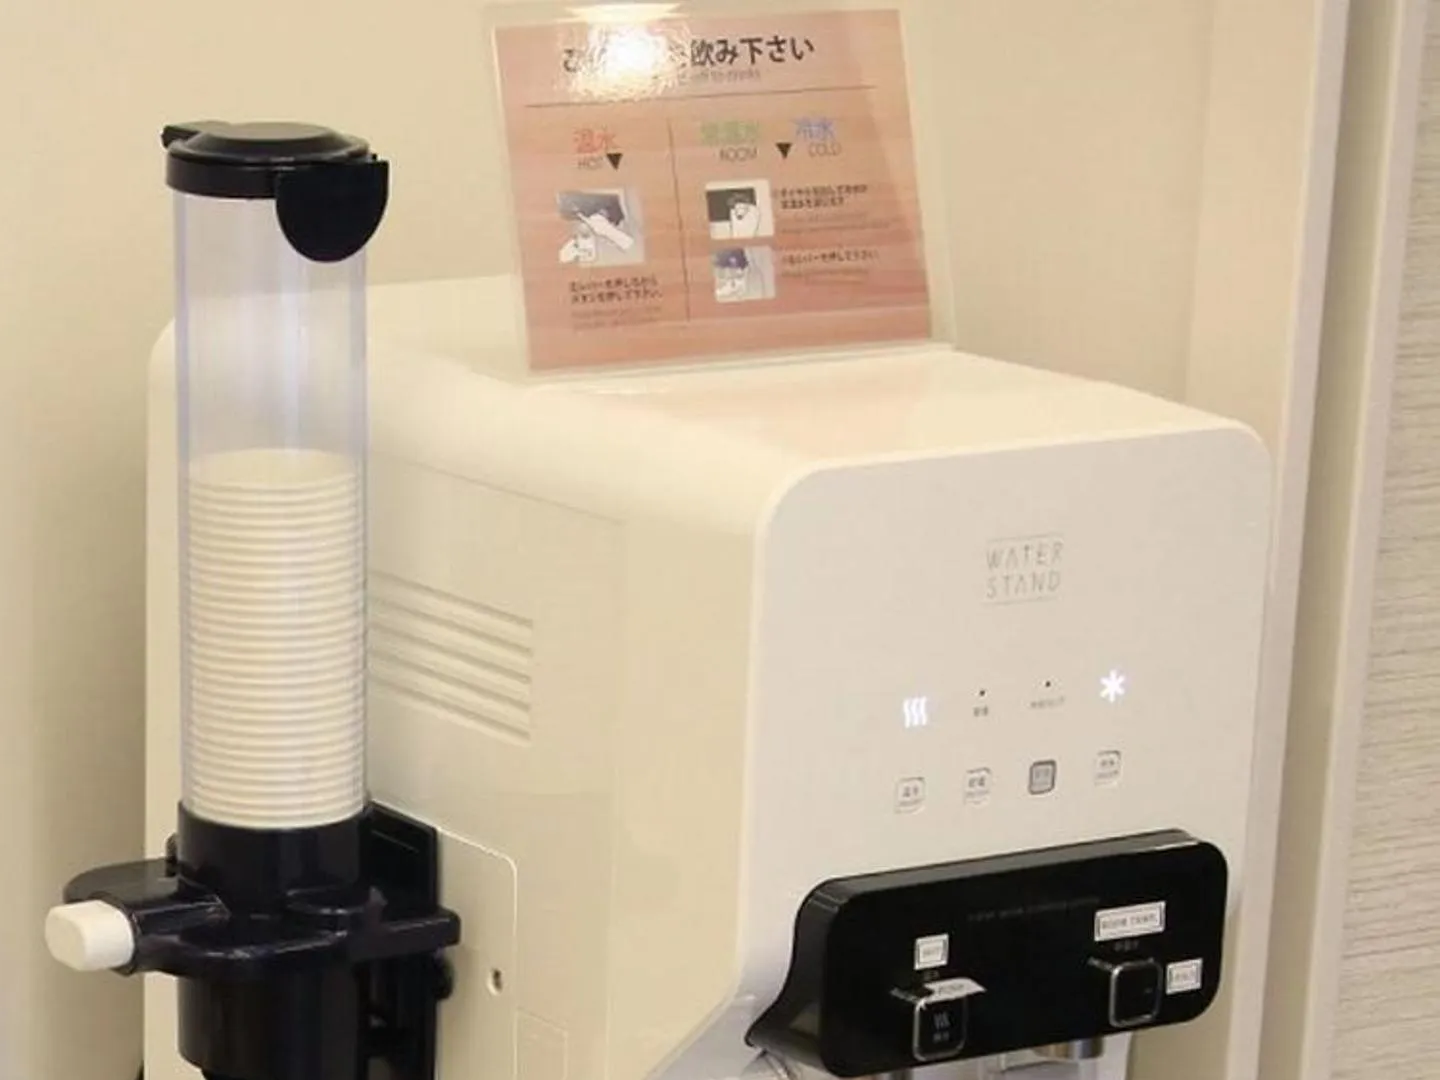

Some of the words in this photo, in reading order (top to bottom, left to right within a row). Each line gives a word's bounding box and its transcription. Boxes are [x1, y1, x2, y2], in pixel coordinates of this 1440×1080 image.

[563, 35, 815, 74] ご飲み下さい
[986, 541, 1063, 571] WATER
[986, 569, 1061, 599] STAND
